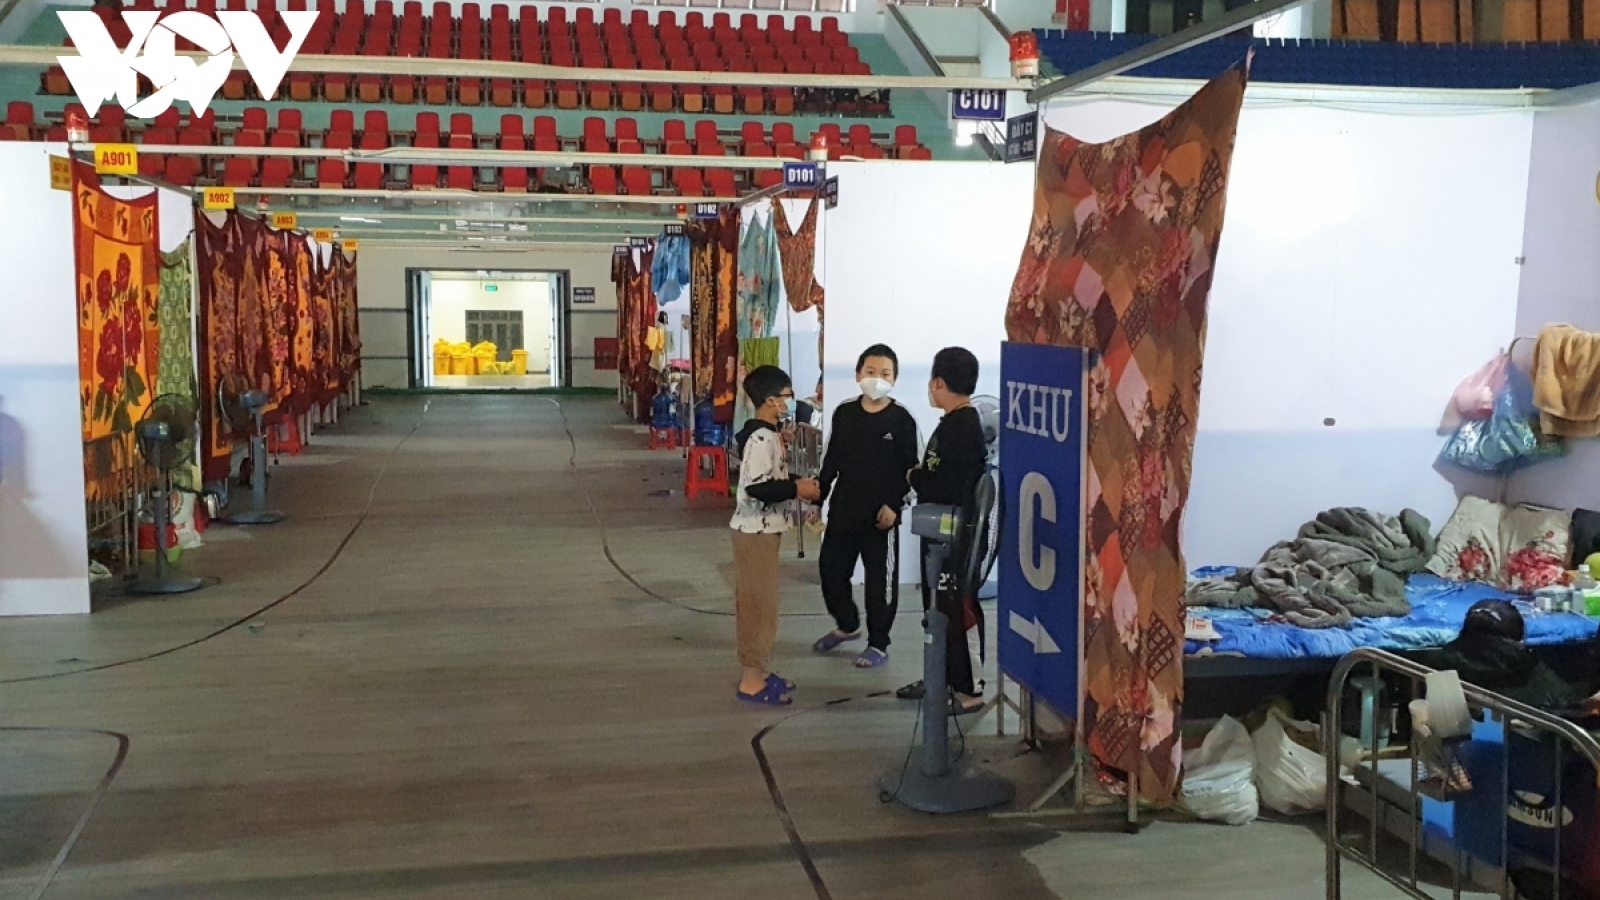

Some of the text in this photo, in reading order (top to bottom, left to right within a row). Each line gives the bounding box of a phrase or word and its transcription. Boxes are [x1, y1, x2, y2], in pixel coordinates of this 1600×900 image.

[960, 89, 999, 111] C101
[101, 150, 132, 167] A901
[788, 168, 815, 184] D101
[208, 192, 230, 205] A902
[697, 203, 717, 215] D102
[1005, 381, 1073, 443] KHU
[1018, 471, 1057, 591] C
